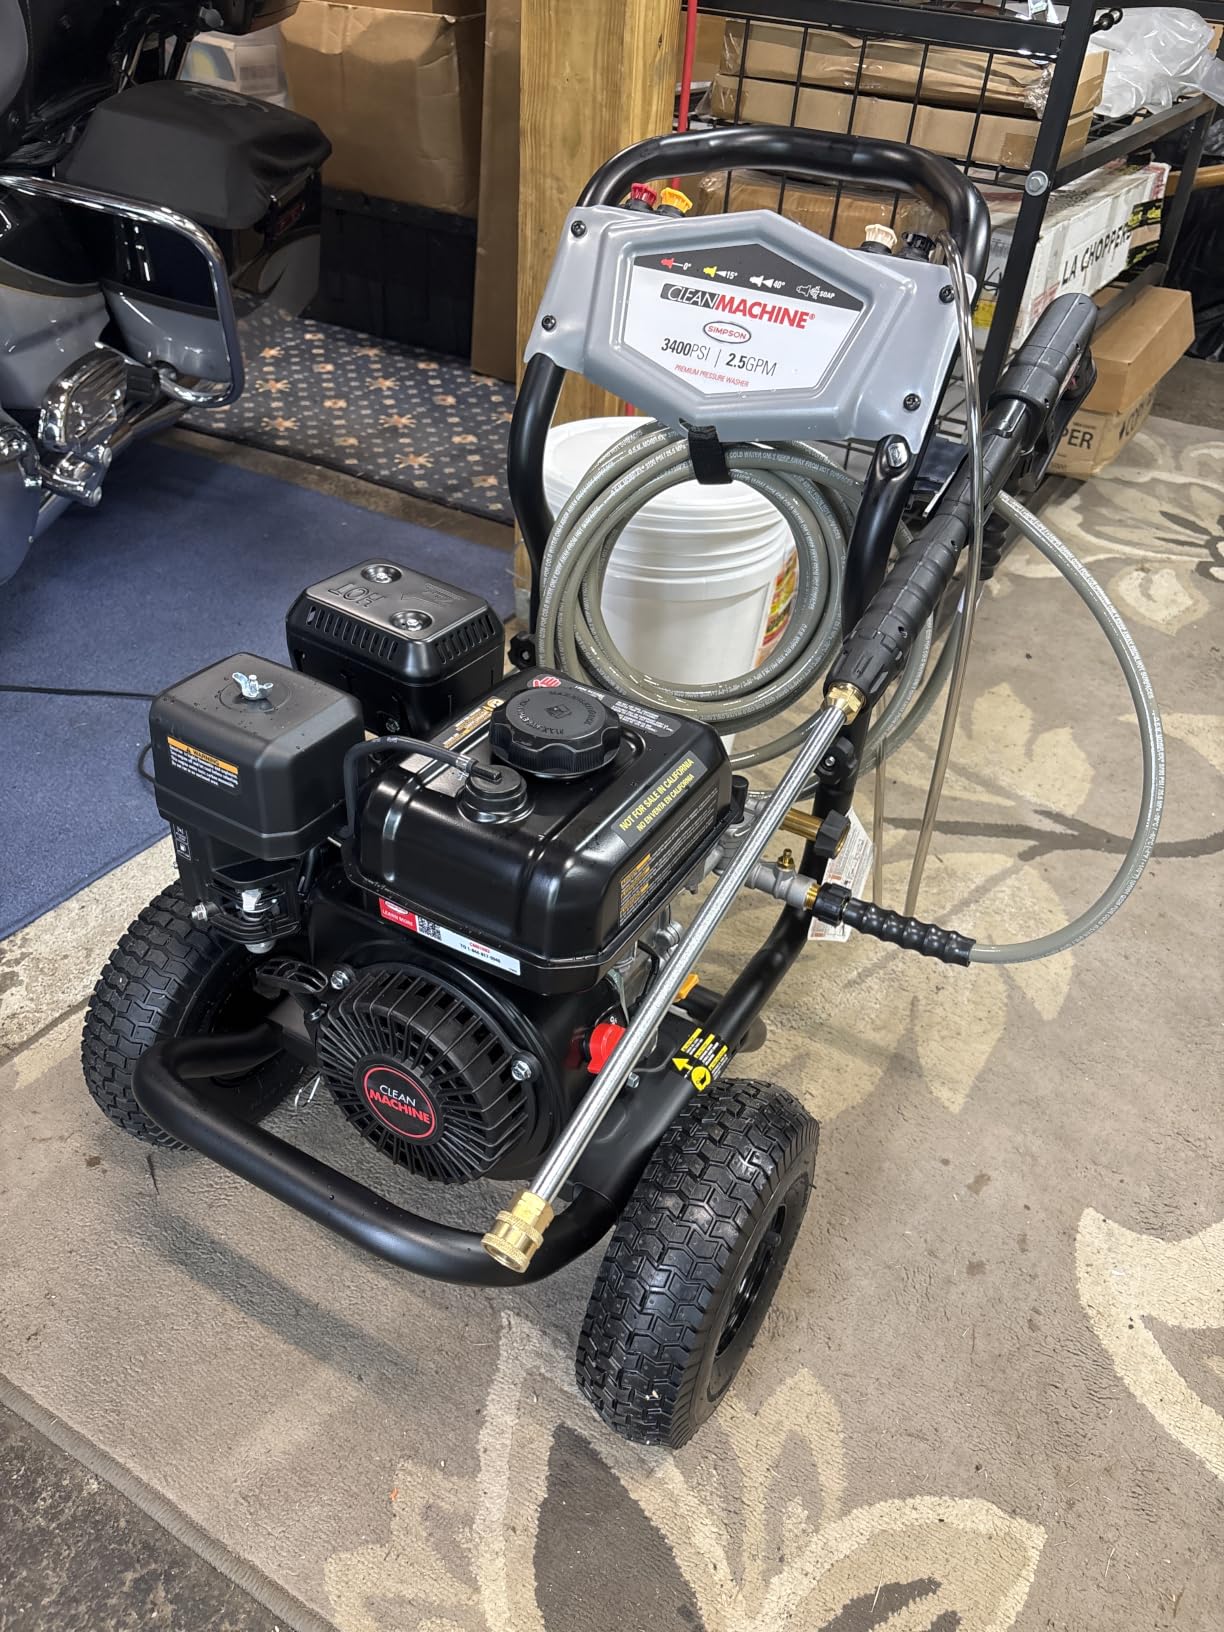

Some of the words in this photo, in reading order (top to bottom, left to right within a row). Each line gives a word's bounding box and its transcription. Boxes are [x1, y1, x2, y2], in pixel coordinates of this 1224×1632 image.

[1062, 255, 1078, 285] LA
[819, 290, 836, 299] SOAP
[707, 324, 747, 340] SIMPSON
[661, 337, 712, 361] 3400PSI
[725, 352, 778, 377] 2.5GPM
[674, 363, 700, 377] PREMIUM
[699, 369, 726, 383] PRESSURE
[726, 375, 750, 387] WASHER
[729, 451, 743, 459] COLD
[744, 450, 762, 459] WATER
[328, 583, 385, 607] HOT
[618, 814, 635, 831] NOT
[632, 804, 647, 819] FOR
[643, 790, 661, 808] SALE
[656, 784, 667, 795] IN
[663, 758, 695, 788] CALIFORNIA
[636, 821, 647, 832] NO
[644, 813, 654, 825] EN
[650, 801, 667, 818] VENTA
[663, 794, 673, 805] EN
[669, 773, 695, 798] CALIFORNIA
[369, 1088, 431, 1125] MACHINE
[379, 1084, 416, 1107] CLEAN
